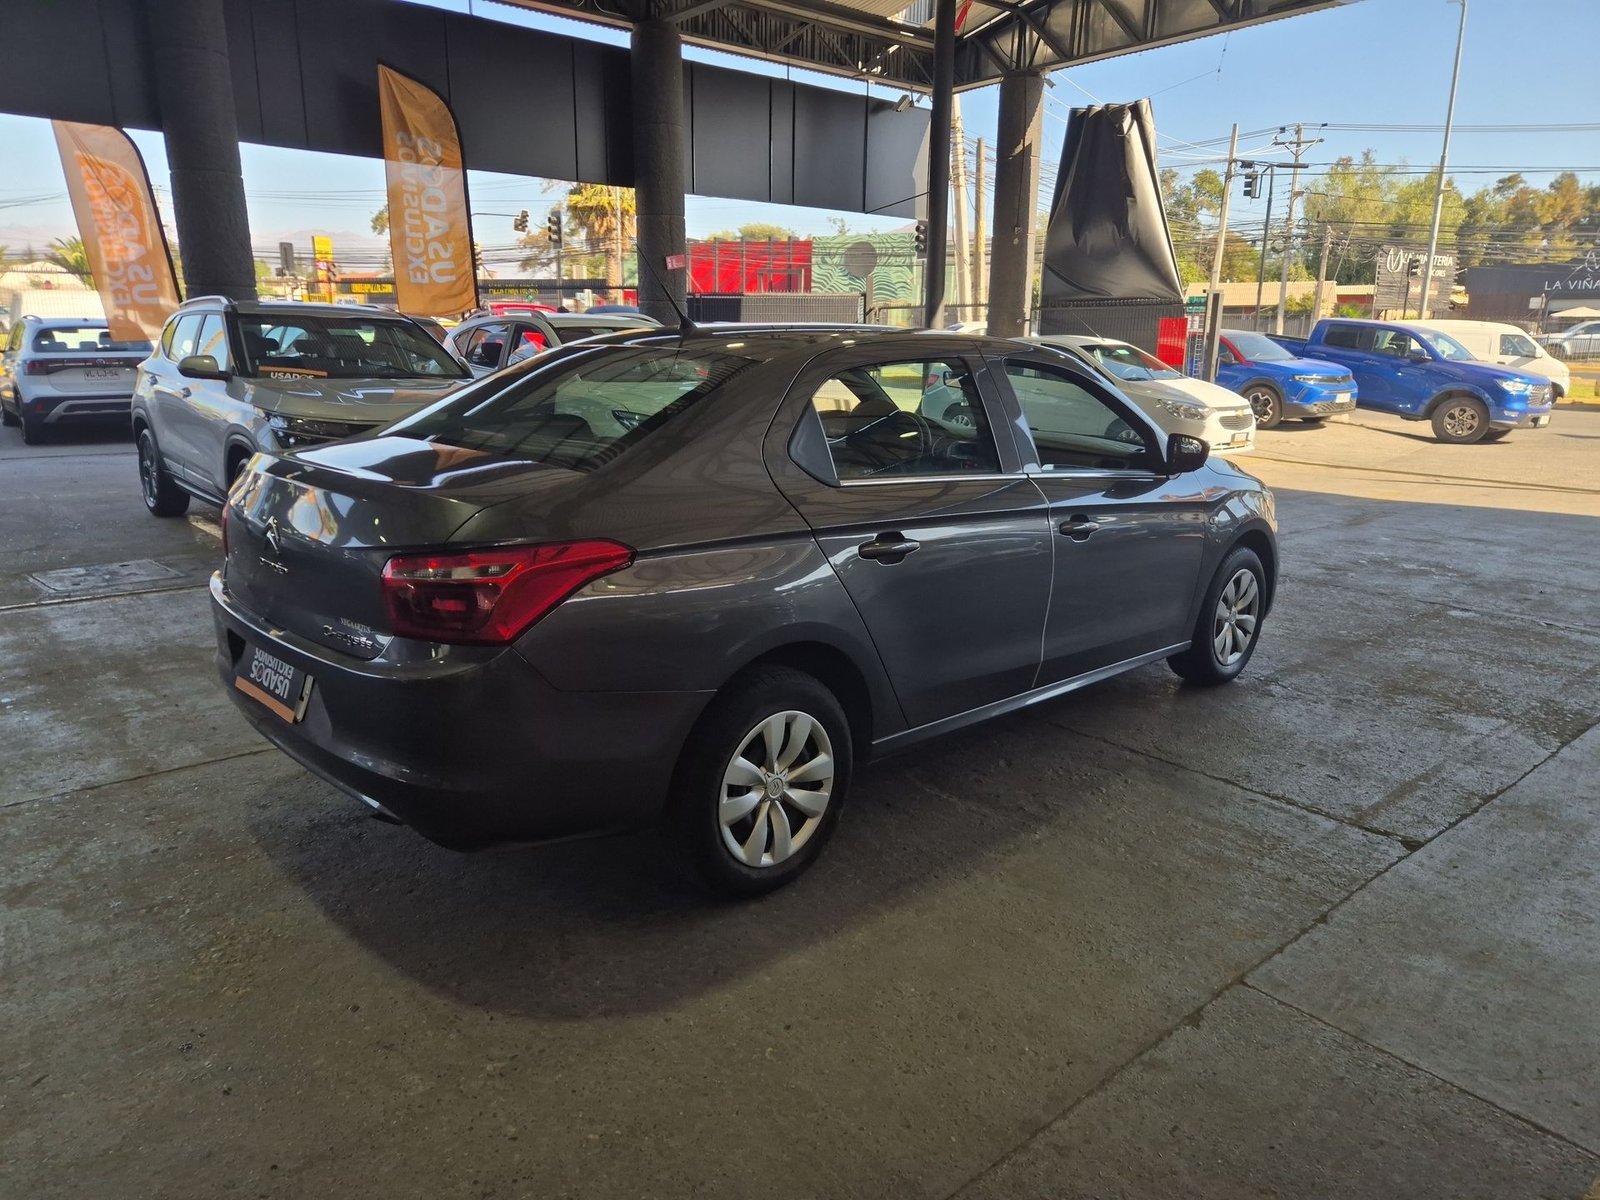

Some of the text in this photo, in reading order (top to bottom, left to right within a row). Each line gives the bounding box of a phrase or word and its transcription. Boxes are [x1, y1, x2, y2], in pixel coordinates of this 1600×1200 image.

[1544, 280, 1562, 290] LA
[249, 660, 291, 699] USADOS
[254, 647, 295, 680] EXCLUSIVOS
